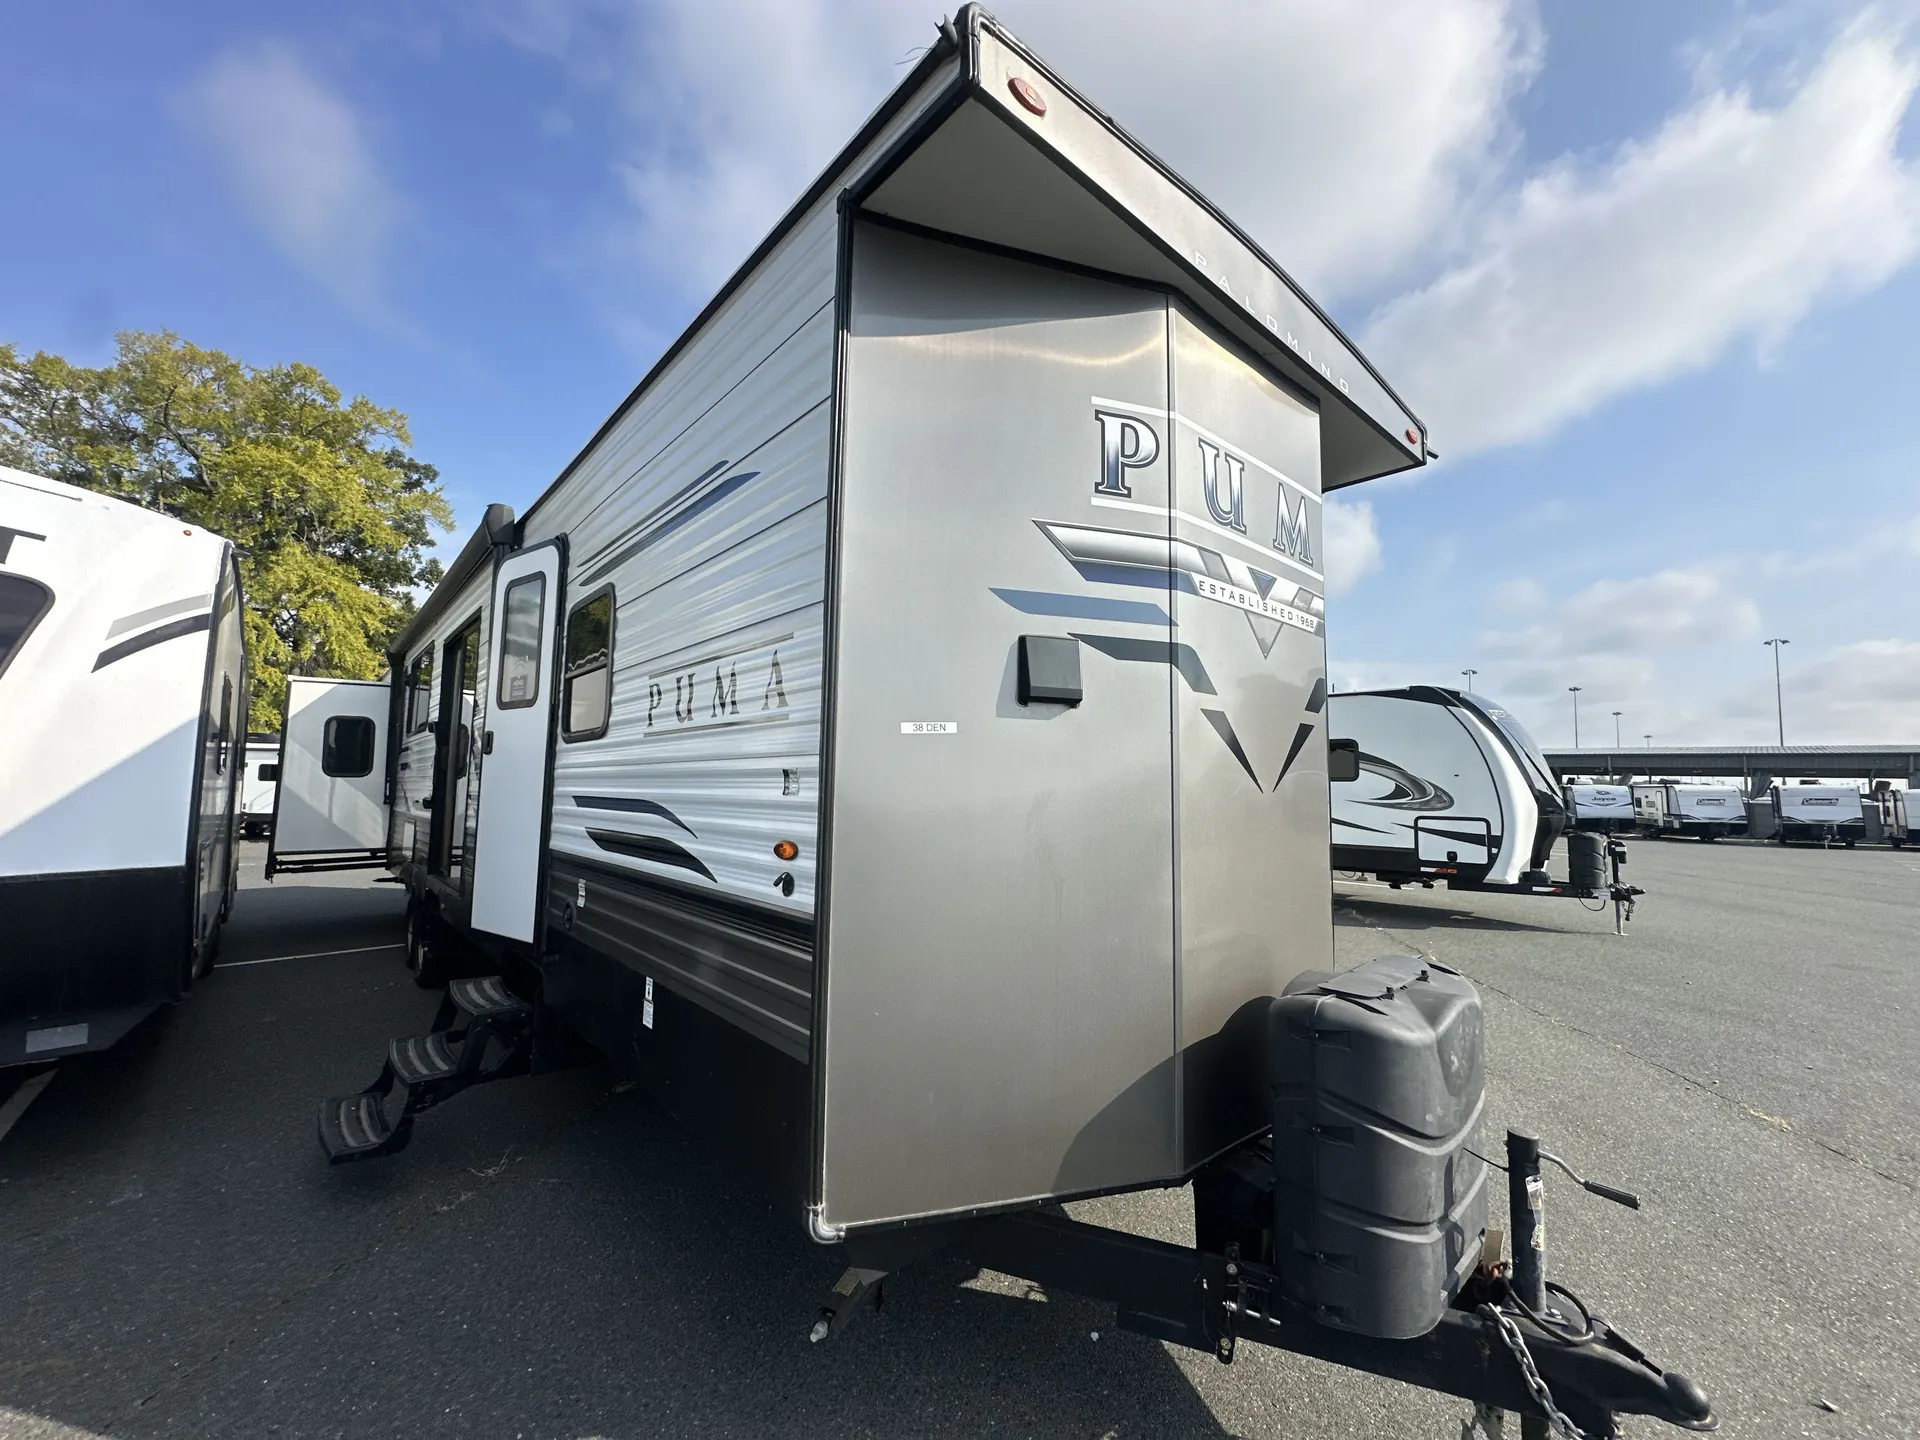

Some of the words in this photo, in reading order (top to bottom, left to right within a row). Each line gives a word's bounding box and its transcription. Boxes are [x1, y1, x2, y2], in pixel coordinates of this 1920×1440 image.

[1195, 250, 1349, 393] PALOMINO
[1199, 580, 1293, 620] ESTABLISHED
[647, 649, 789, 727] PUMA
[912, 723, 924, 732] 38
[926, 723, 946, 732] DEN
